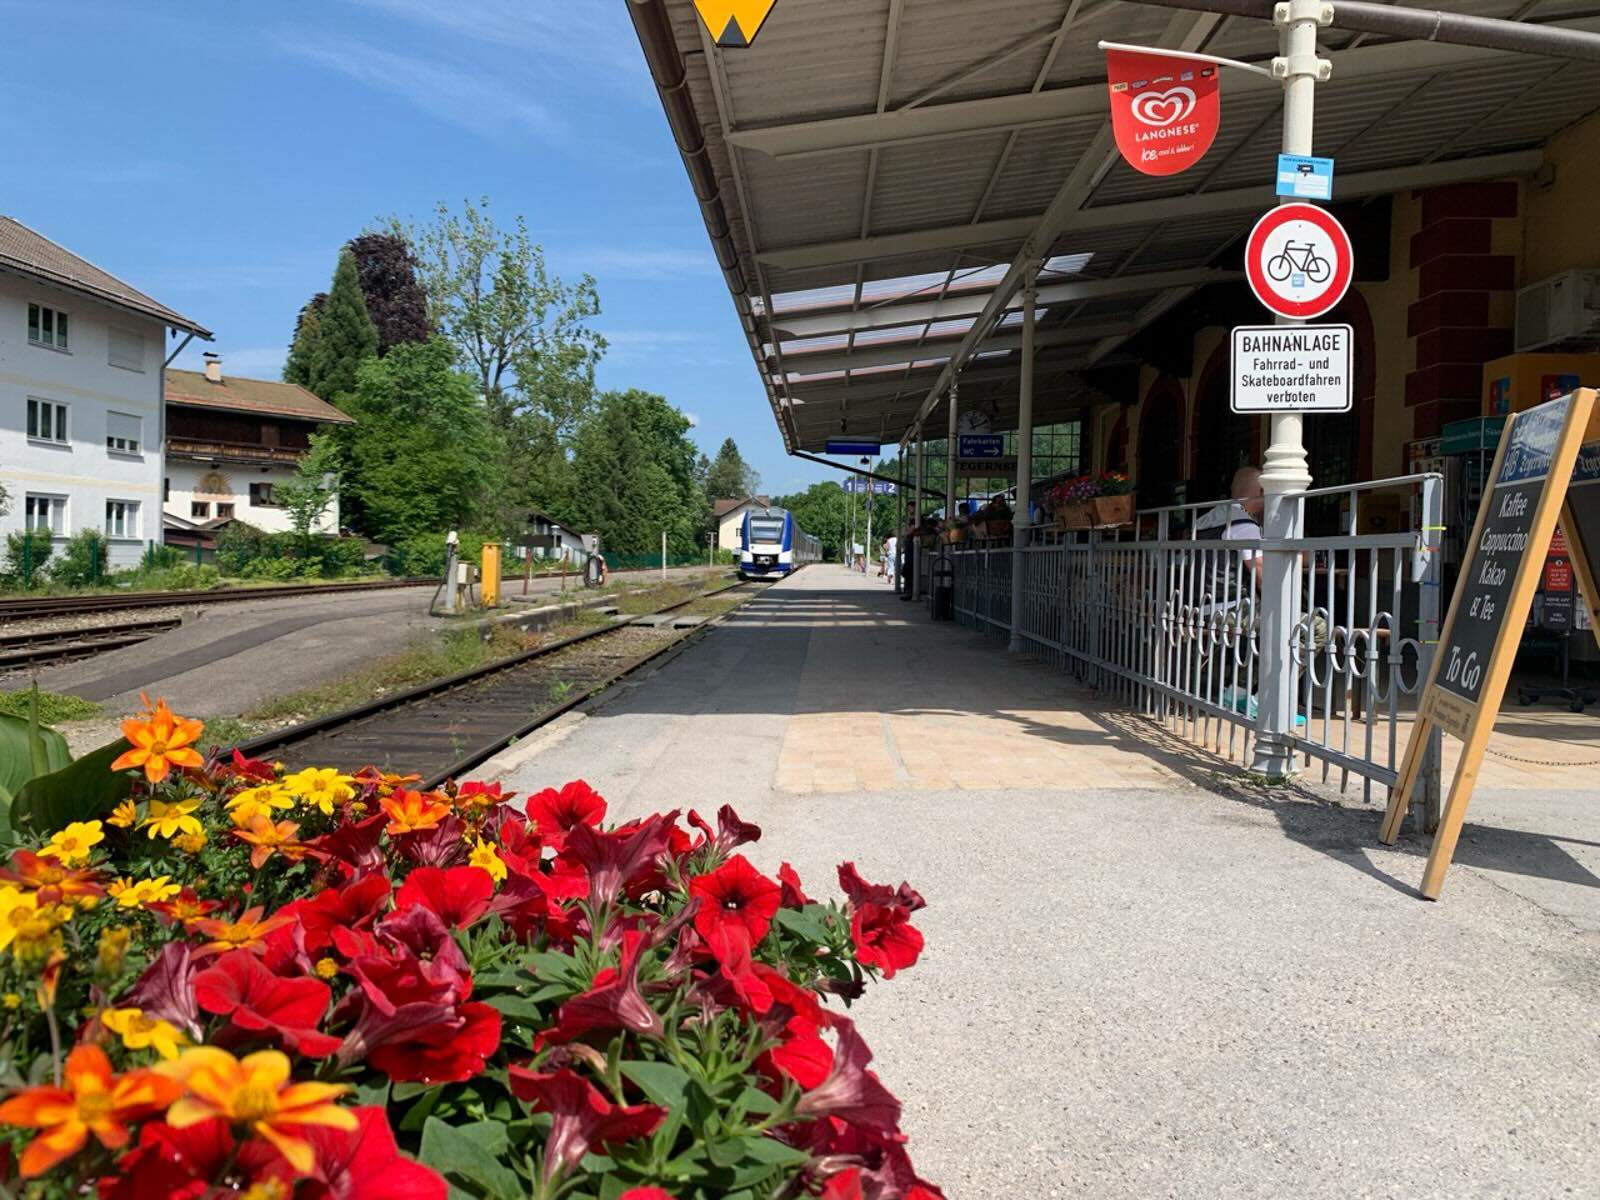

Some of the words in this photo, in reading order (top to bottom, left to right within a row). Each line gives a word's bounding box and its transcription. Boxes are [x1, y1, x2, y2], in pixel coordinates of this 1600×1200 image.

[1135, 125, 1196, 142] LANGNESE
[1243, 334, 1340, 353] BAHNANLAGE
[1253, 357, 1303, 371] Fahrrad-
[1309, 357, 1330, 370] und
[1242, 373, 1341, 387] Skateboardfahren
[1267, 390, 1316, 404] verboten
[846, 482, 852, 491] 1
[887, 483, 896, 493] 2
[1498, 491, 1528, 518] Kaffee
[1480, 527, 1528, 556] Cappuccino
[1478, 560, 1506, 586] Kakao
[1469, 597, 1481, 617] &
[1480, 595, 1495, 621] Tee
[1446, 645, 1461, 682] To
[1461, 651, 1481, 691] Go
